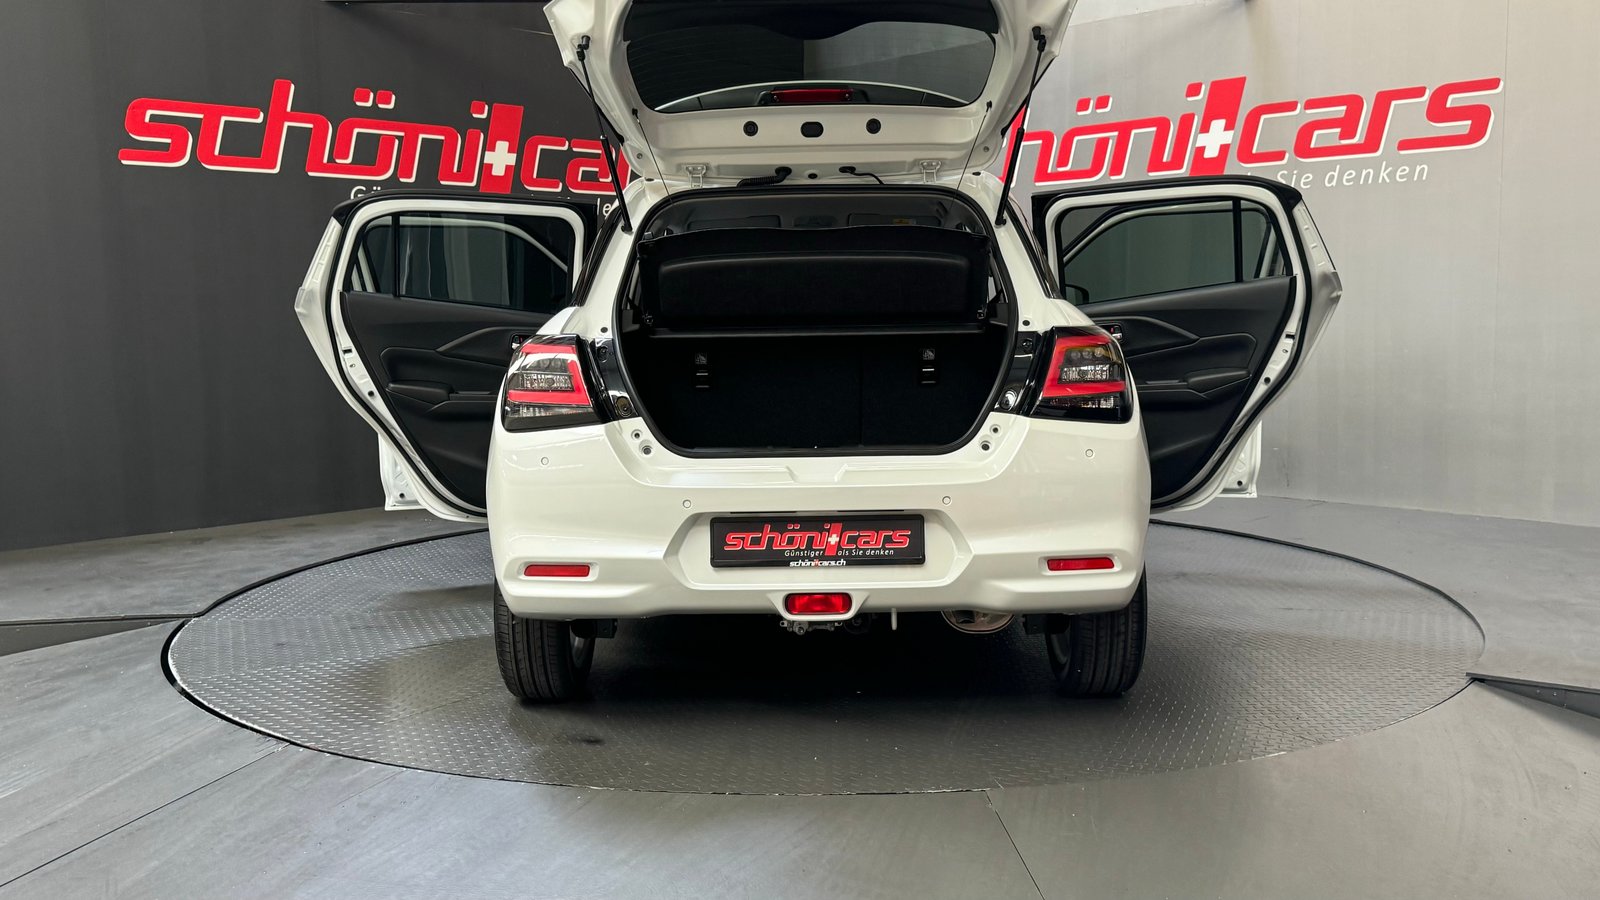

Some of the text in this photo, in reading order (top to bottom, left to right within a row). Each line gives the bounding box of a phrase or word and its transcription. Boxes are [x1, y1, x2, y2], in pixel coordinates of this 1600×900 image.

[1324, 161, 1429, 188] denken
[784, 549, 824, 558] Günstiger
[851, 548, 863, 556] Sie
[865, 547, 895, 556] denken
